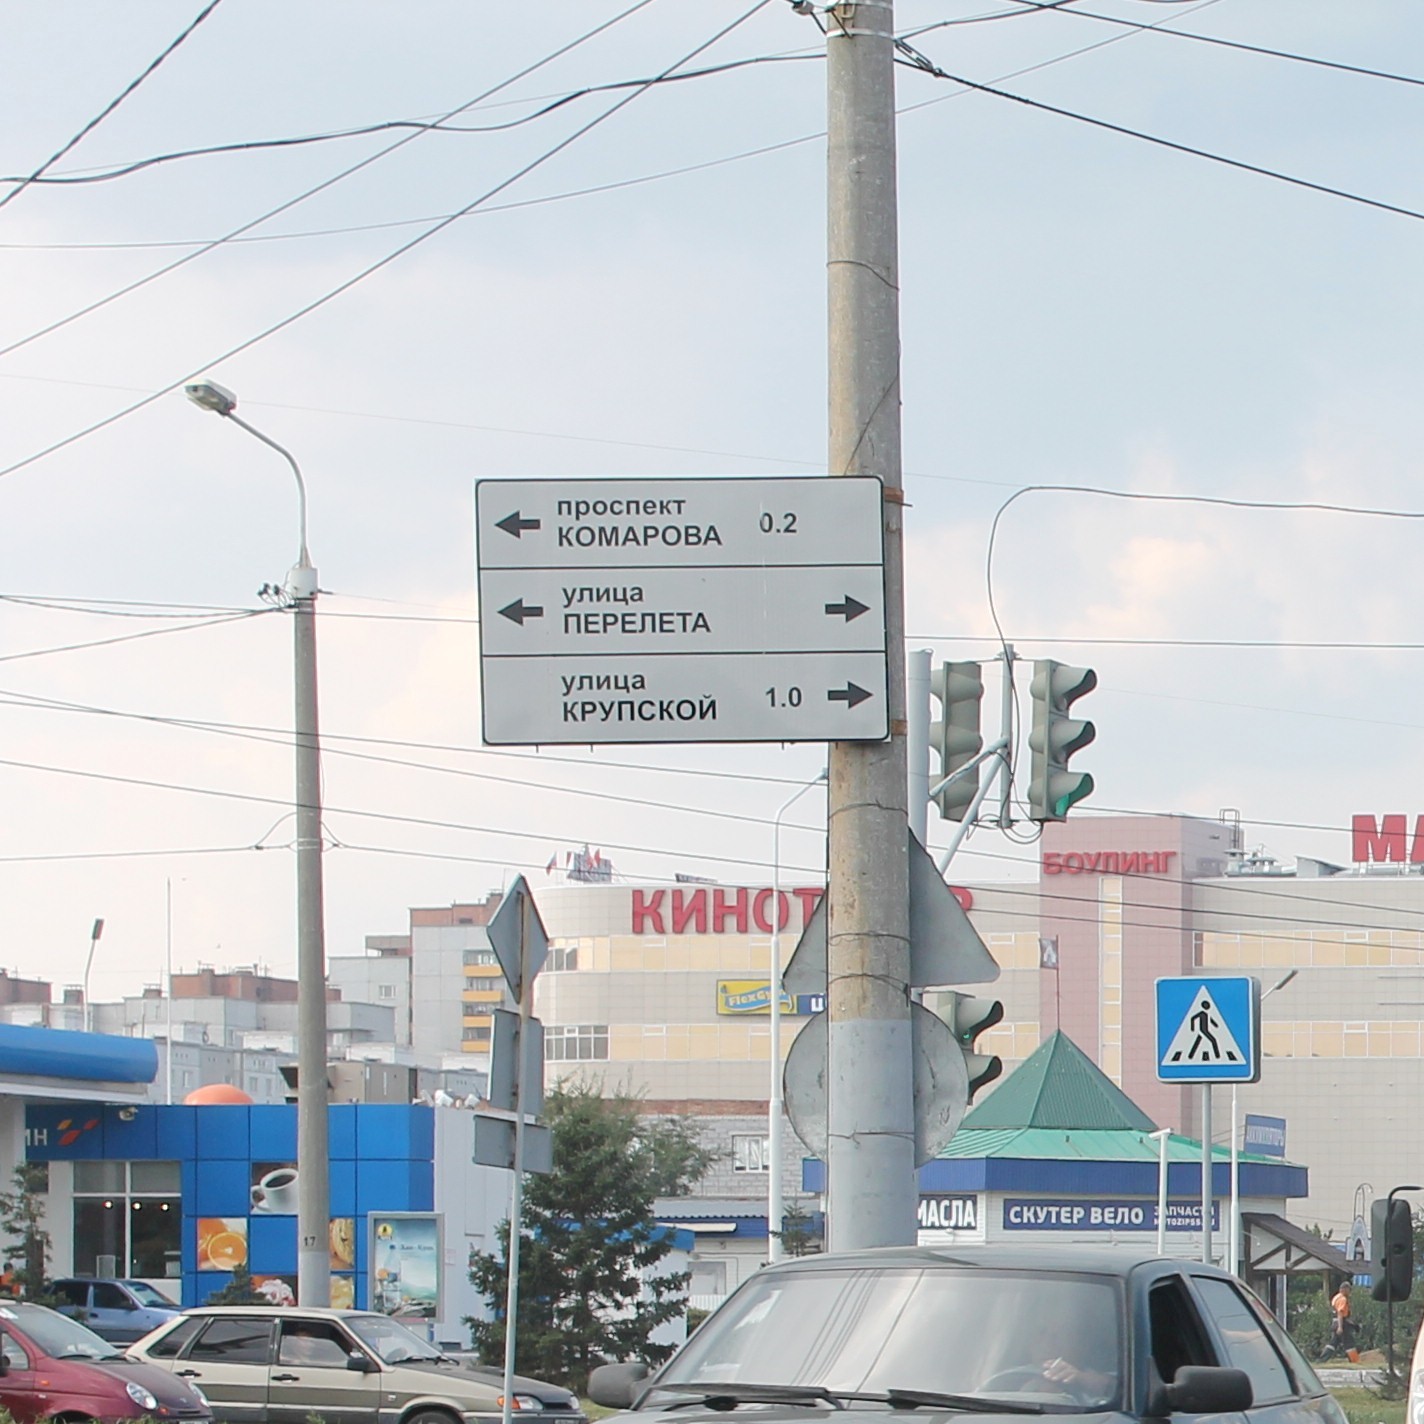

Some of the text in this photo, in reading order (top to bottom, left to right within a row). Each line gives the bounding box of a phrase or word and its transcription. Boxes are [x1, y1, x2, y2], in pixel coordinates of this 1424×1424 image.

[556, 499, 686, 521] проспект
[557, 512, 797, 547] КОМАРОВА 0.2
[562, 586, 644, 608] улица
[563, 613, 711, 634] ПЕРЕЛЕТА
[561, 674, 646, 696] улица
[563, 687, 802, 722] КРУПСКОЙ 1.0
[1043, 851, 1177, 875] БОУЛИНГ
[1008, 1205, 1144, 1225] СКУТЕР ВЕЛО
[302, 1236, 317, 1247] 17
